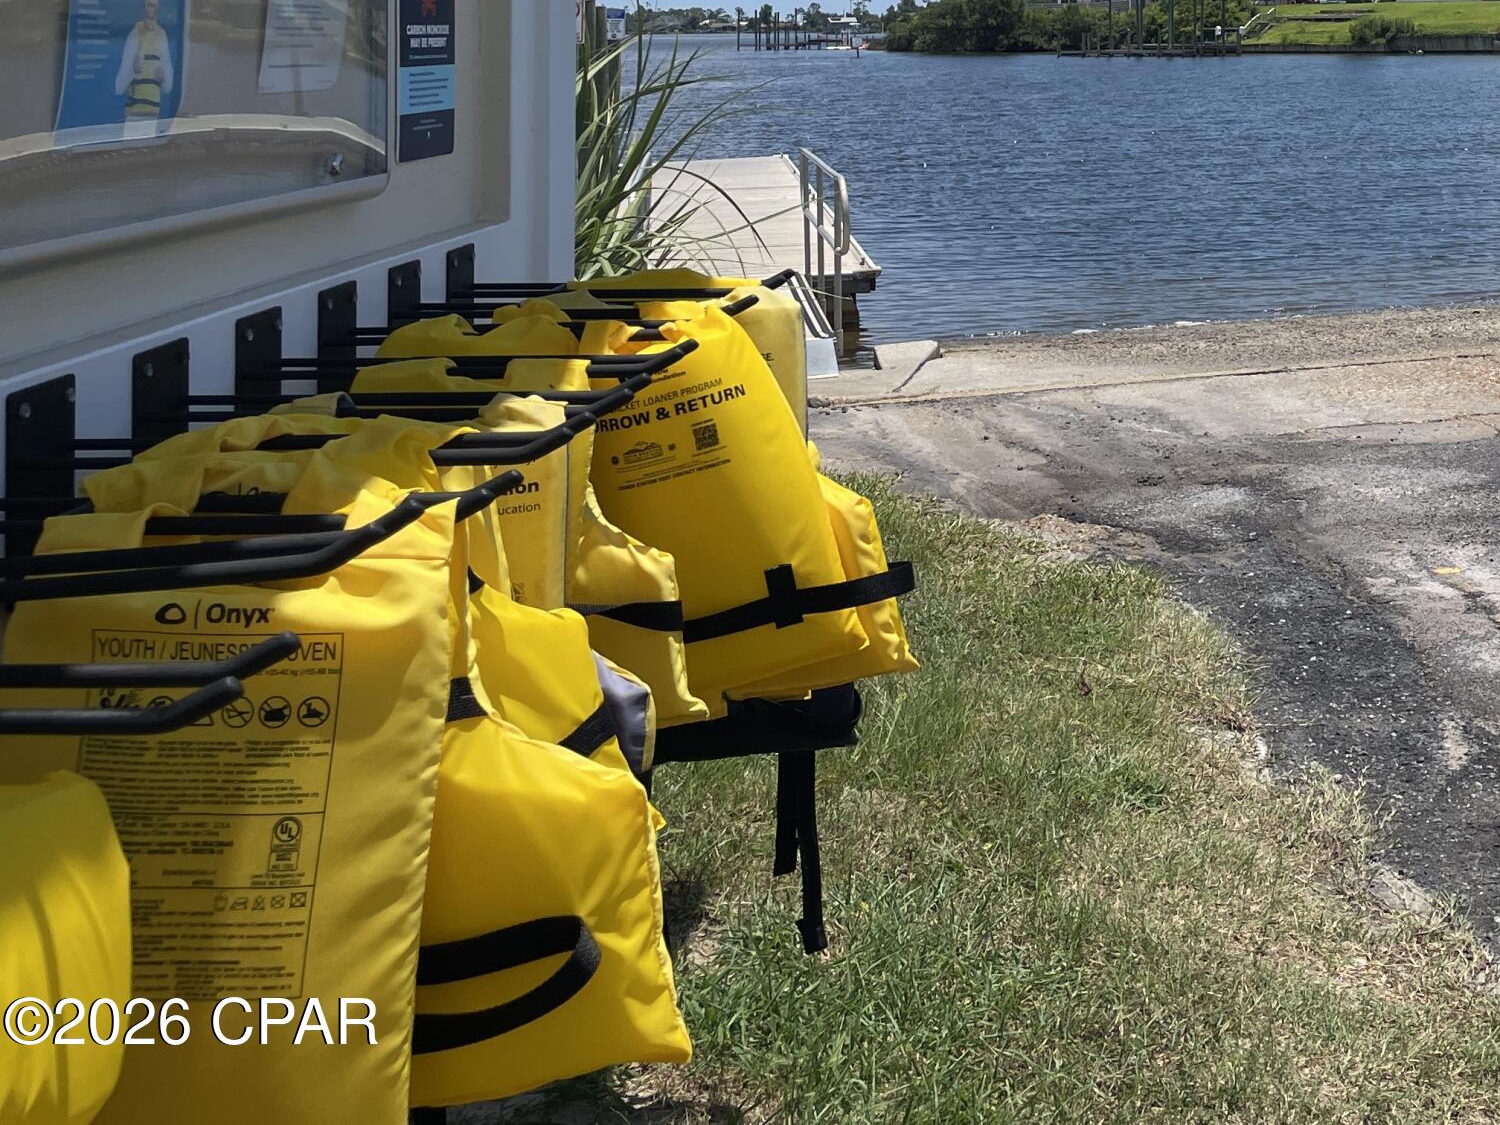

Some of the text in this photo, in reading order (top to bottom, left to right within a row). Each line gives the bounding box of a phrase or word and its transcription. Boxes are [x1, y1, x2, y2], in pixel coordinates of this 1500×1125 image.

[643, 390, 679, 409] LOANER
[680, 378, 723, 397] PROGRAM
[594, 383, 747, 434] RROW & RETURN
[498, 502, 541, 515] ucation
[98, 638, 154, 660] YOUTH
